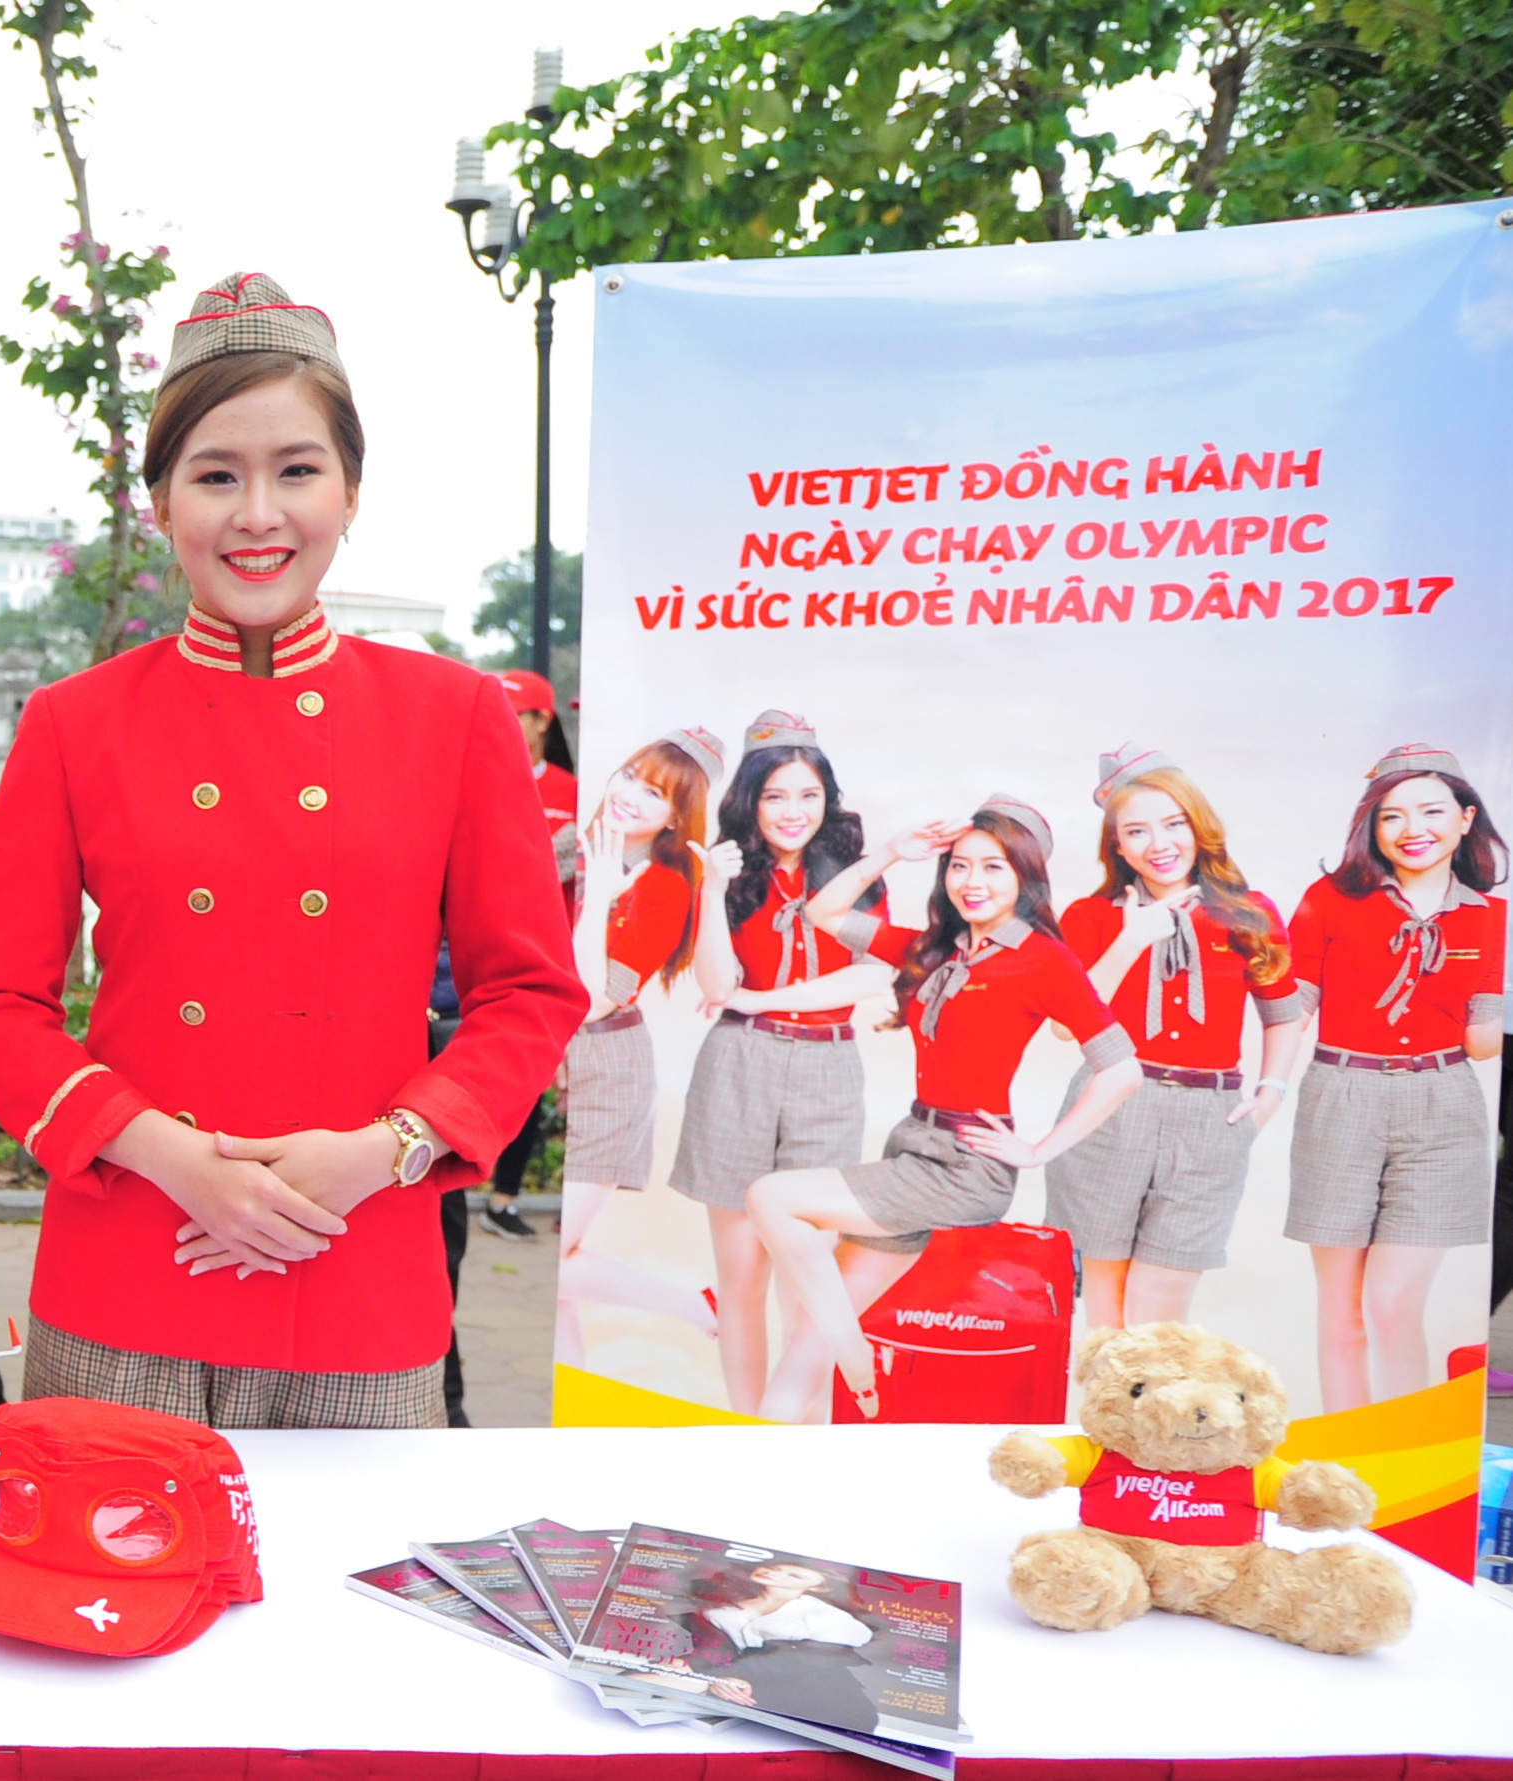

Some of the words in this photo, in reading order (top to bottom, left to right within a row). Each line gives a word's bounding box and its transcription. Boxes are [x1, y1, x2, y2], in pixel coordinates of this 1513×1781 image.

[747, 463, 951, 512] VIETJET
[960, 444, 1130, 502] ĐỒNG
[1144, 442, 1323, 495] HÀNH
[739, 519, 894, 573] NGÀY
[902, 523, 1056, 574] CHẠY
[1064, 513, 1330, 561] OLYMPIC
[633, 584, 686, 631] VÌ
[694, 579, 793, 632] SỨC
[803, 571, 955, 629] KHOẺ
[966, 565, 1136, 626] NHÂN
[1149, 570, 1283, 623] DÂN
[1297, 575, 1456, 619] 2017
[1149, 1496, 1225, 1523] Air.com
[857, 1569, 951, 1600] LY!
